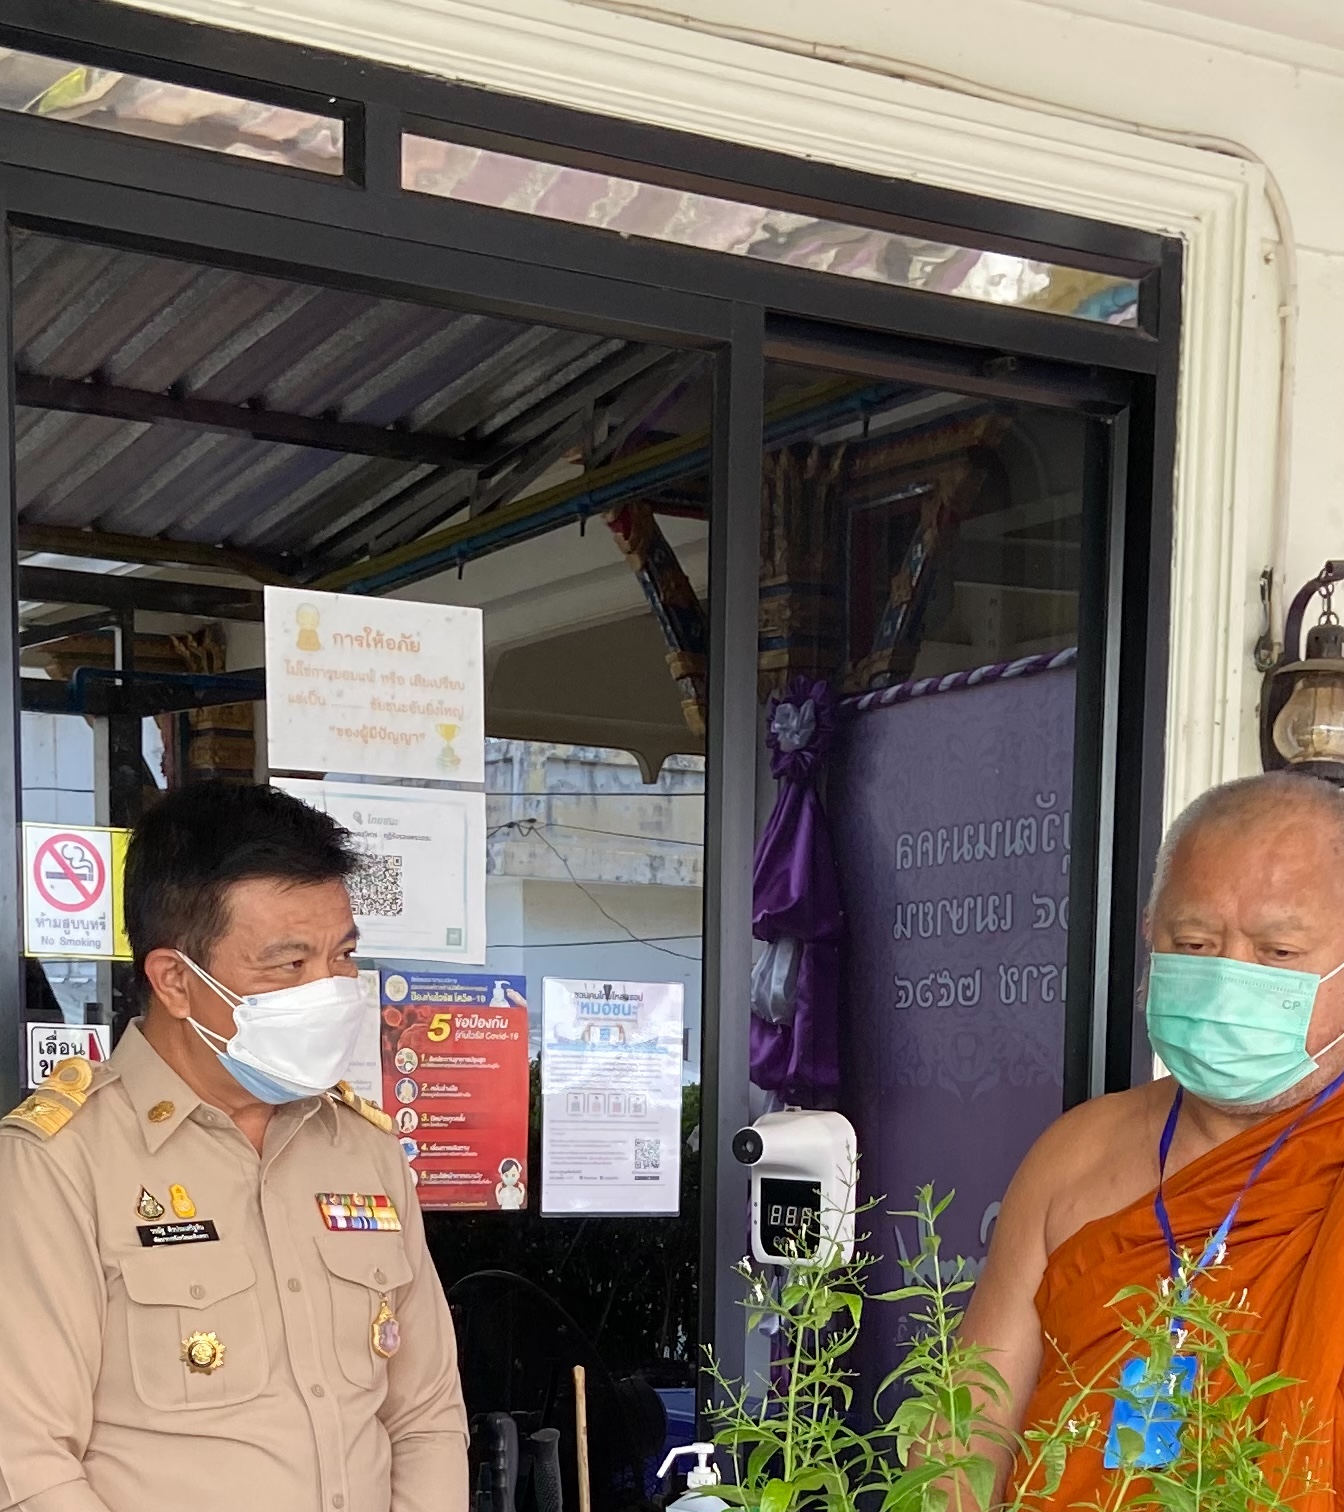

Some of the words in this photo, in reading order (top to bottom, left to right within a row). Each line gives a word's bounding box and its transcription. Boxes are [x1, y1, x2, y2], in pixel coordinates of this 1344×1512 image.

[332, 626, 421, 653] การให้อภัย
[35, 911, 106, 936] ห้ามสูบบุหรี่
[41, 935, 54, 946] No
[59, 937, 101, 949] Smoking
[427, 1014, 452, 1042] 5
[455, 1014, 509, 1030] ข้อป้องกัน
[39, 1029, 85, 1056] เลื่อน
